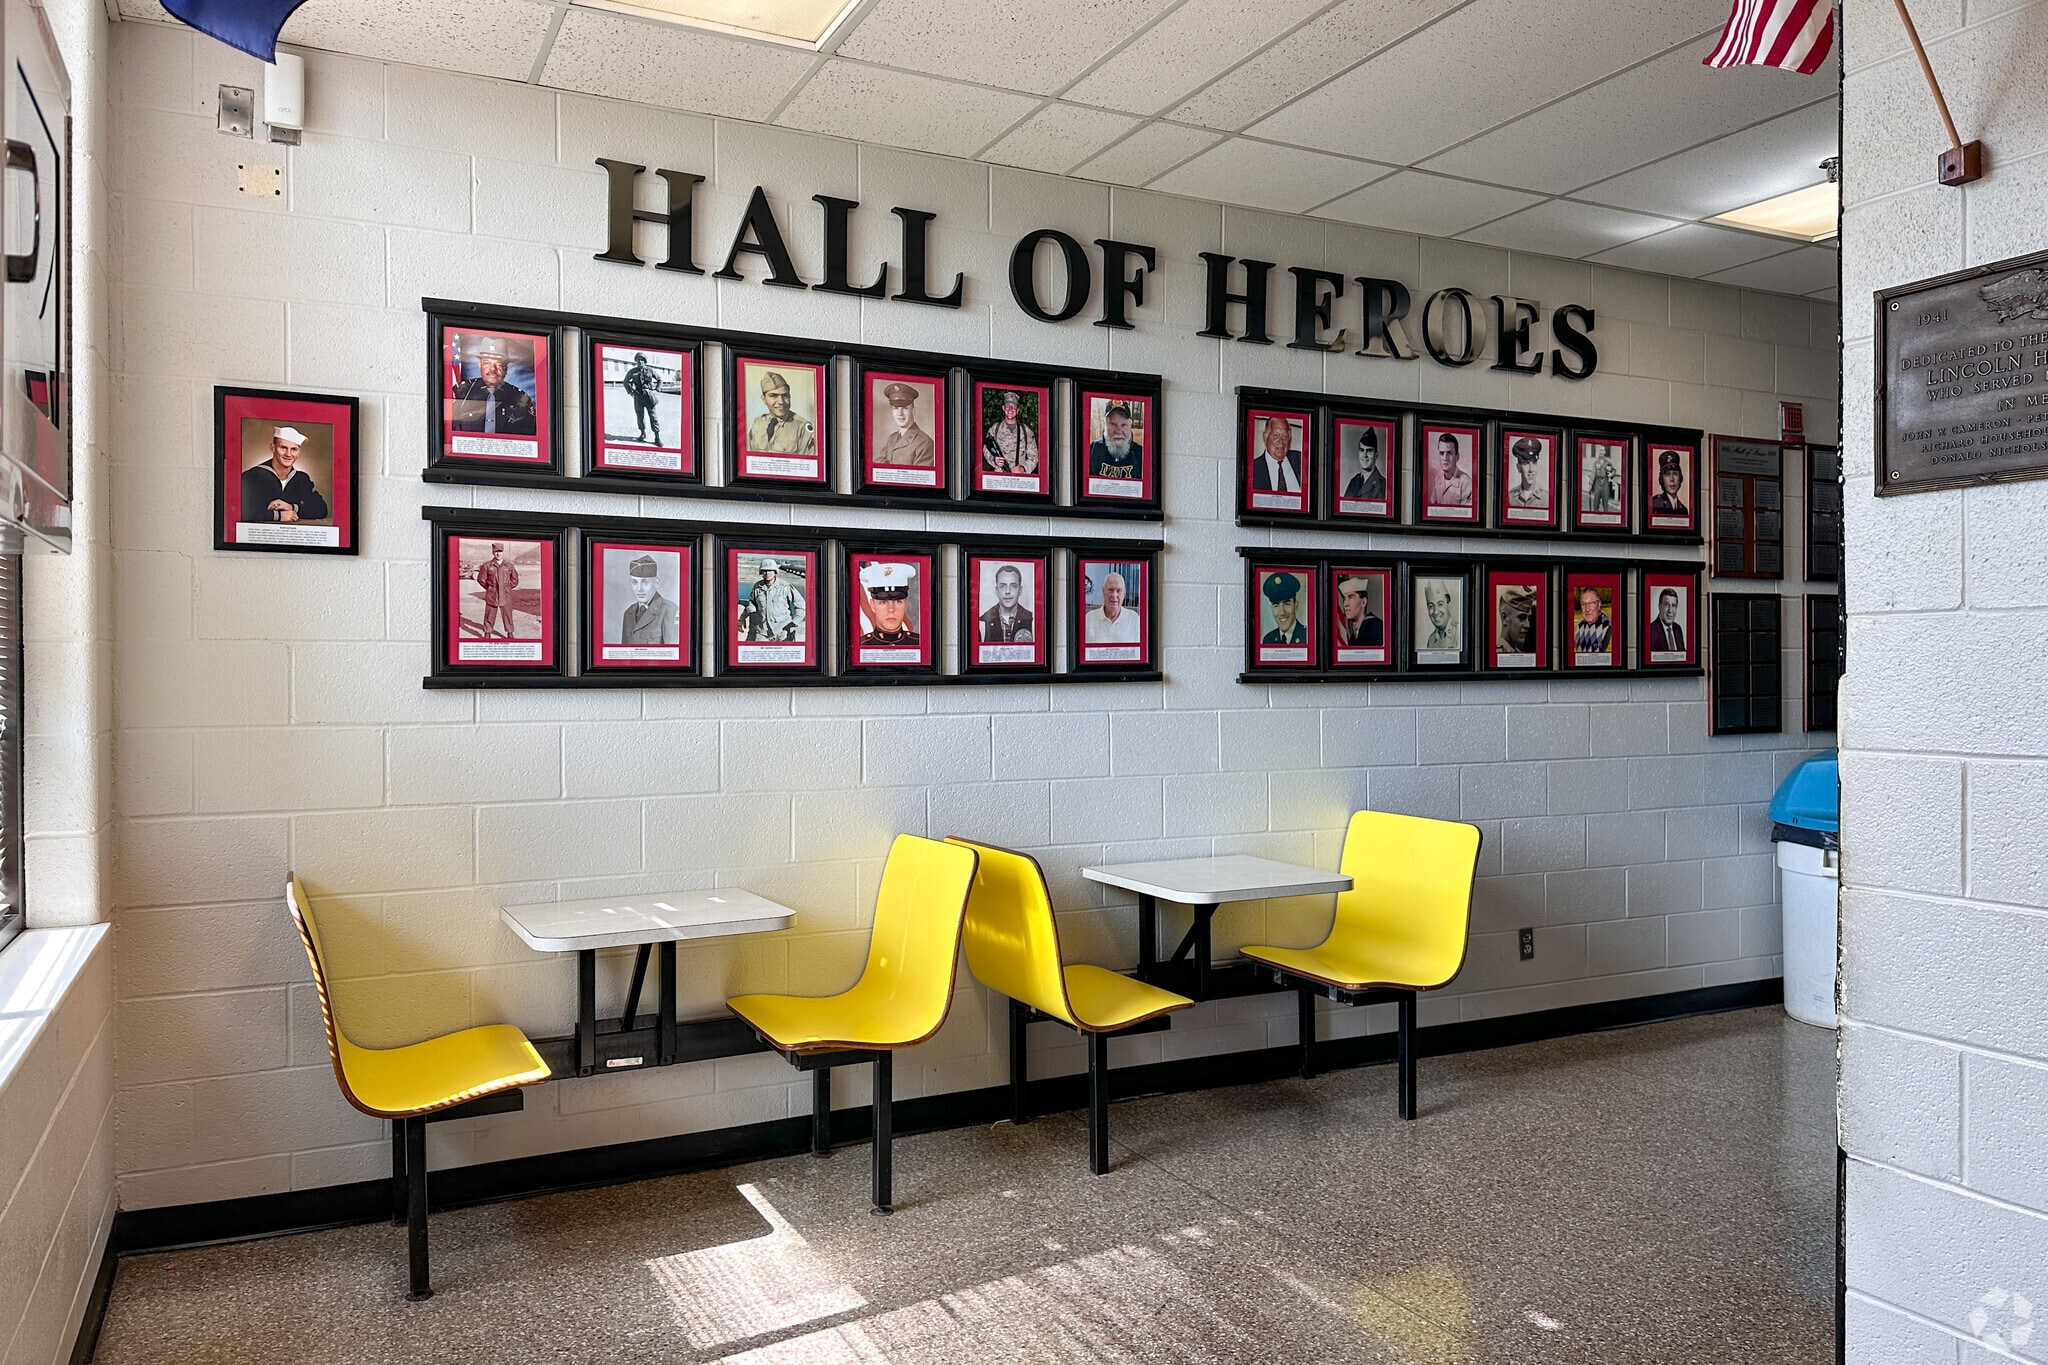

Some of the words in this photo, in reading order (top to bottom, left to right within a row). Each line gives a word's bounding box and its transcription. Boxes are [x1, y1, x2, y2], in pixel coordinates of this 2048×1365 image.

[593, 157, 964, 309] HALL
[1008, 229, 1156, 329] OF
[1196, 251, 1596, 380] HEROES
[1916, 309, 1948, 327] 1941
[1901, 344, 1988, 371] DEDICATED
[1993, 339, 2014, 353] TO
[2019, 331, 2048, 348] THE
[1926, 353, 2023, 386] LINCOLN
[1926, 385, 1963, 402] WHO
[1973, 373, 2034, 394] SERVED
[1997, 398, 2016, 412] IN
[2026, 393, 2048, 407] ME
[1901, 428, 1933, 443] JOHN
[1951, 418, 2011, 435] CAMERON
[1920, 437, 1975, 454] RICHARD
[1931, 451, 1982, 466] DONALD
[1989, 441, 2048, 458] NICHOLS
[1098, 462, 1134, 478] NAVY
